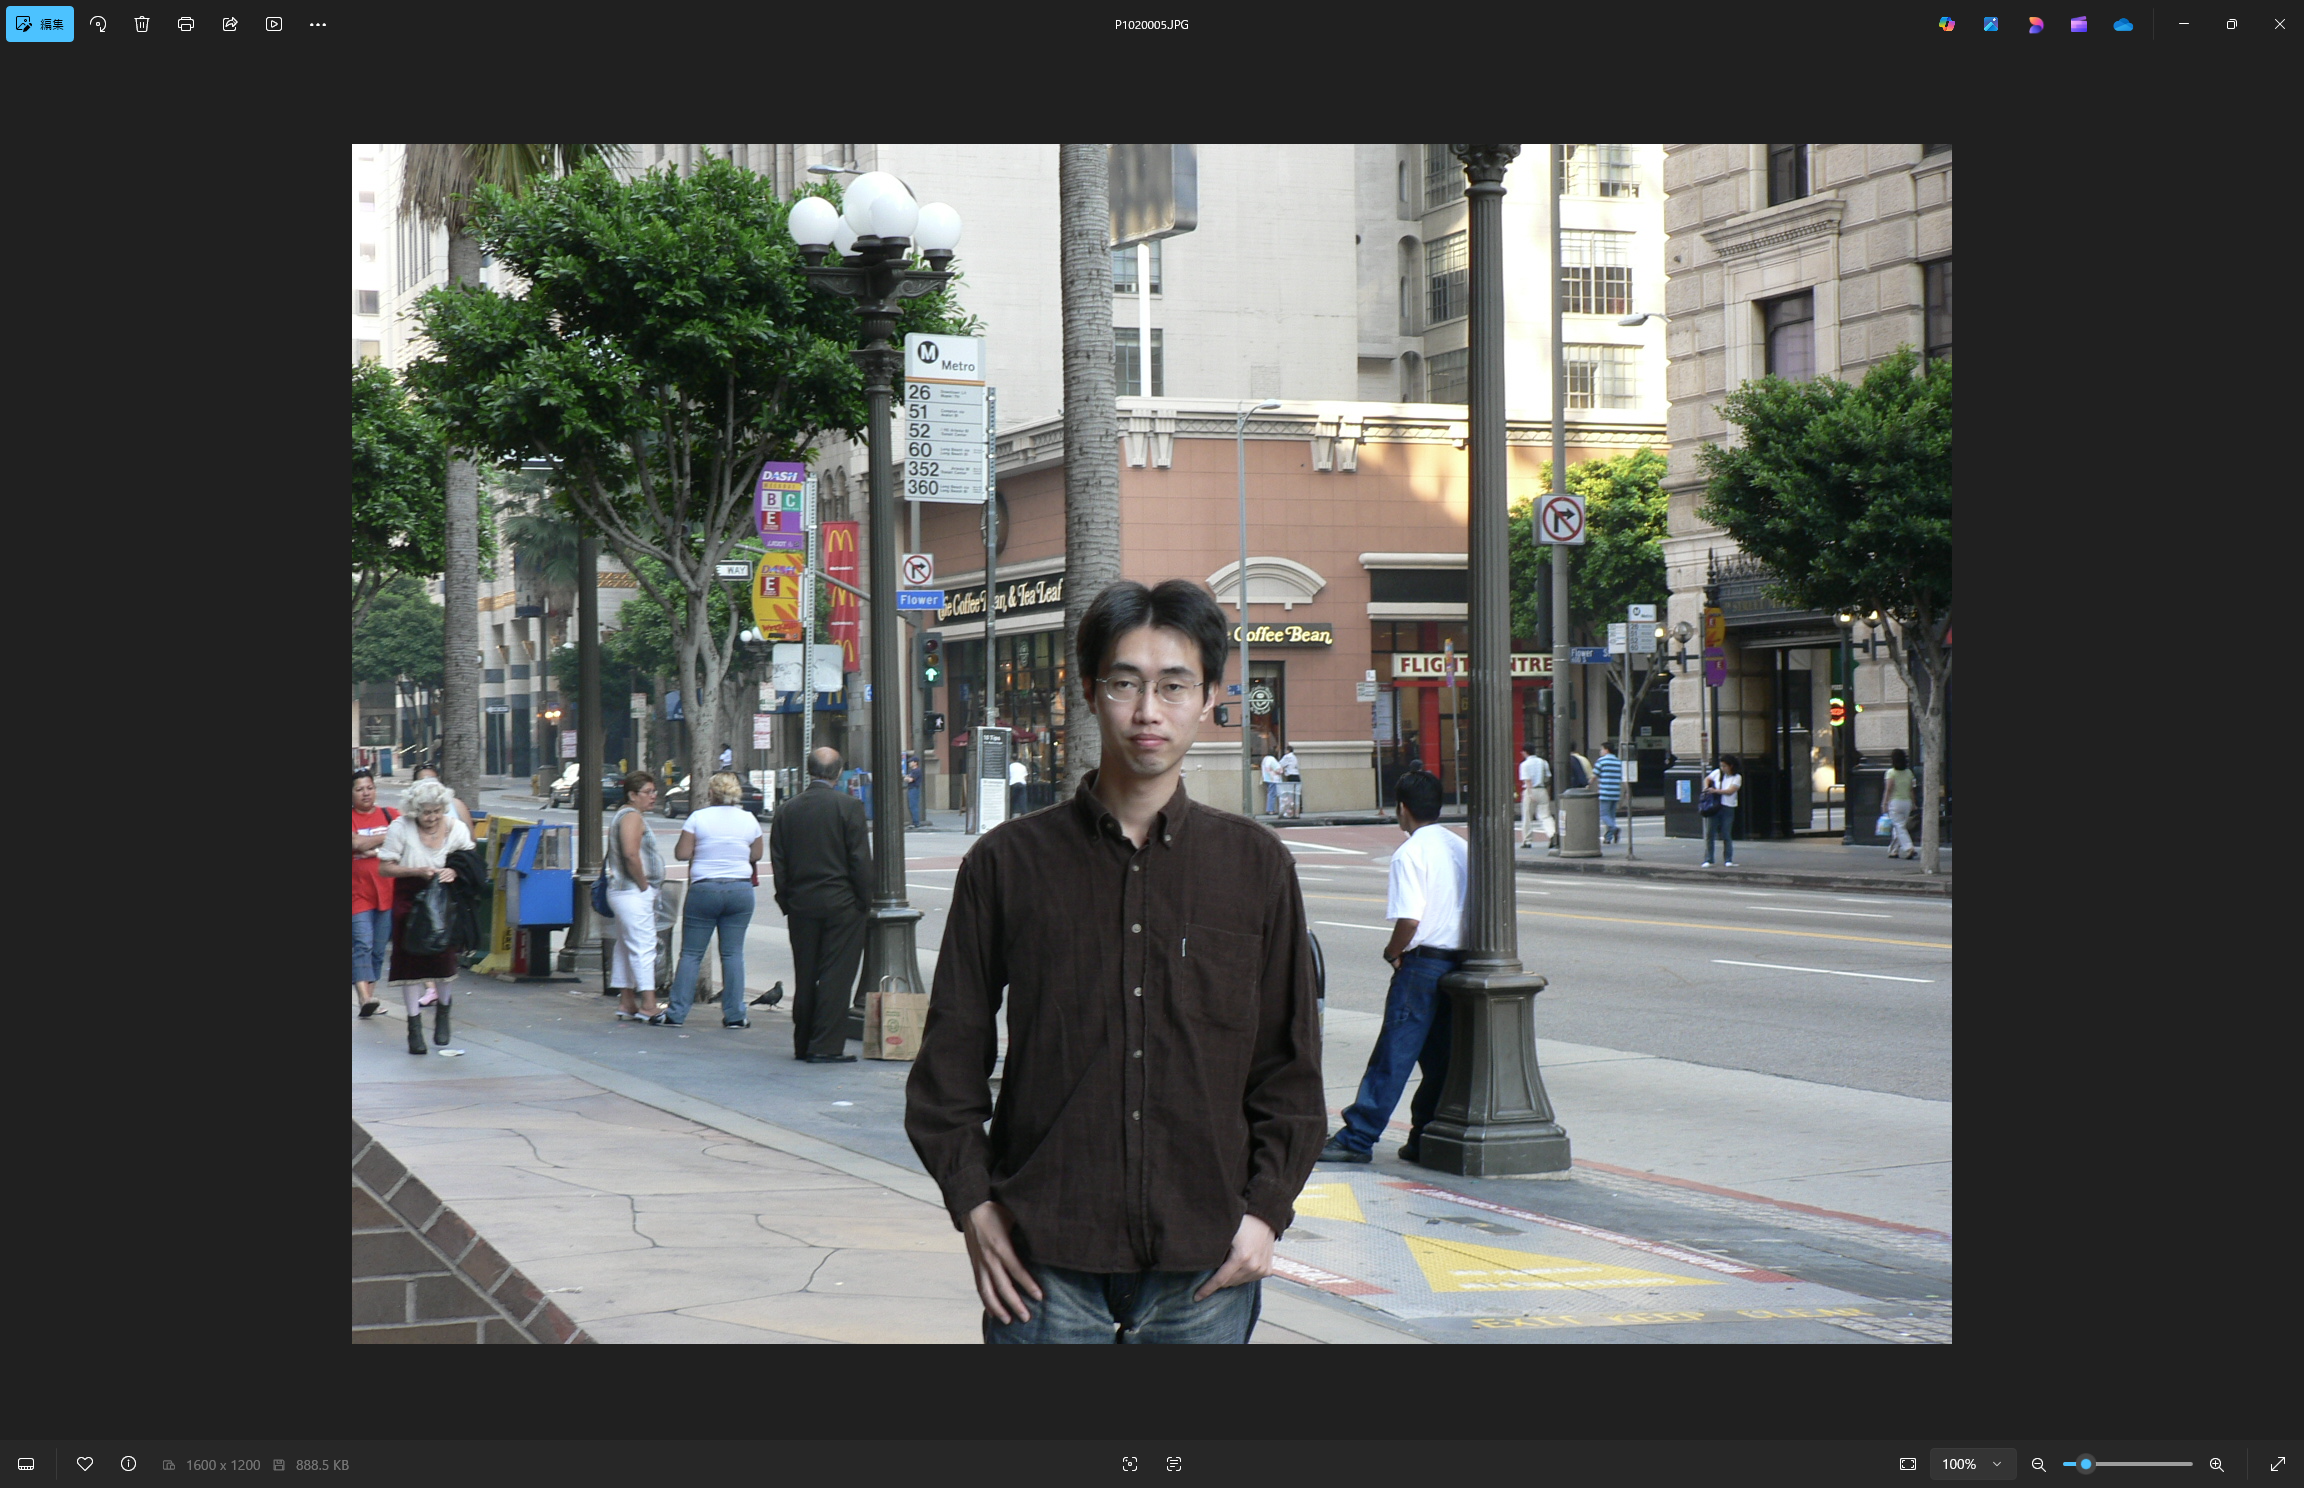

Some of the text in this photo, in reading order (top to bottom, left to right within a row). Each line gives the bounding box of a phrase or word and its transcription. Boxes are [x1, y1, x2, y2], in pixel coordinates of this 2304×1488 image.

[40, 19, 64, 31] 編集
[1115, 19, 1190, 30] P1020005.JPG
[920, 344, 937, 361] M
[942, 360, 975, 372] Metro
[908, 384, 931, 400] 26
[908, 403, 927, 419] 51
[909, 423, 931, 438] 52
[908, 442, 932, 457] 60
[762, 471, 798, 481] DASH
[908, 461, 939, 477] 352
[908, 479, 939, 495] 360
[767, 493, 796, 507] B C
[766, 511, 776, 525] E
[727, 566, 746, 574] WAY
[762, 565, 796, 575] DASH
[765, 576, 776, 591] E
[900, 594, 939, 605] Flower
[953, 592, 980, 617] Coffee
[1008, 585, 1017, 608] &
[1017, 582, 1036, 607] Tea
[1037, 578, 1064, 604] Leaf
[1234, 626, 1284, 642] Coffee
[1285, 625, 1333, 645] Bean
[1571, 649, 1593, 658] Flower
[1473, 1307, 1875, 1328] EXIT KEEP CLEAR
[186, 1459, 261, 1472] 1600 x 1200
[295, 1459, 350, 1472] 888.5 KB
[1942, 1458, 1977, 1470] 100%
